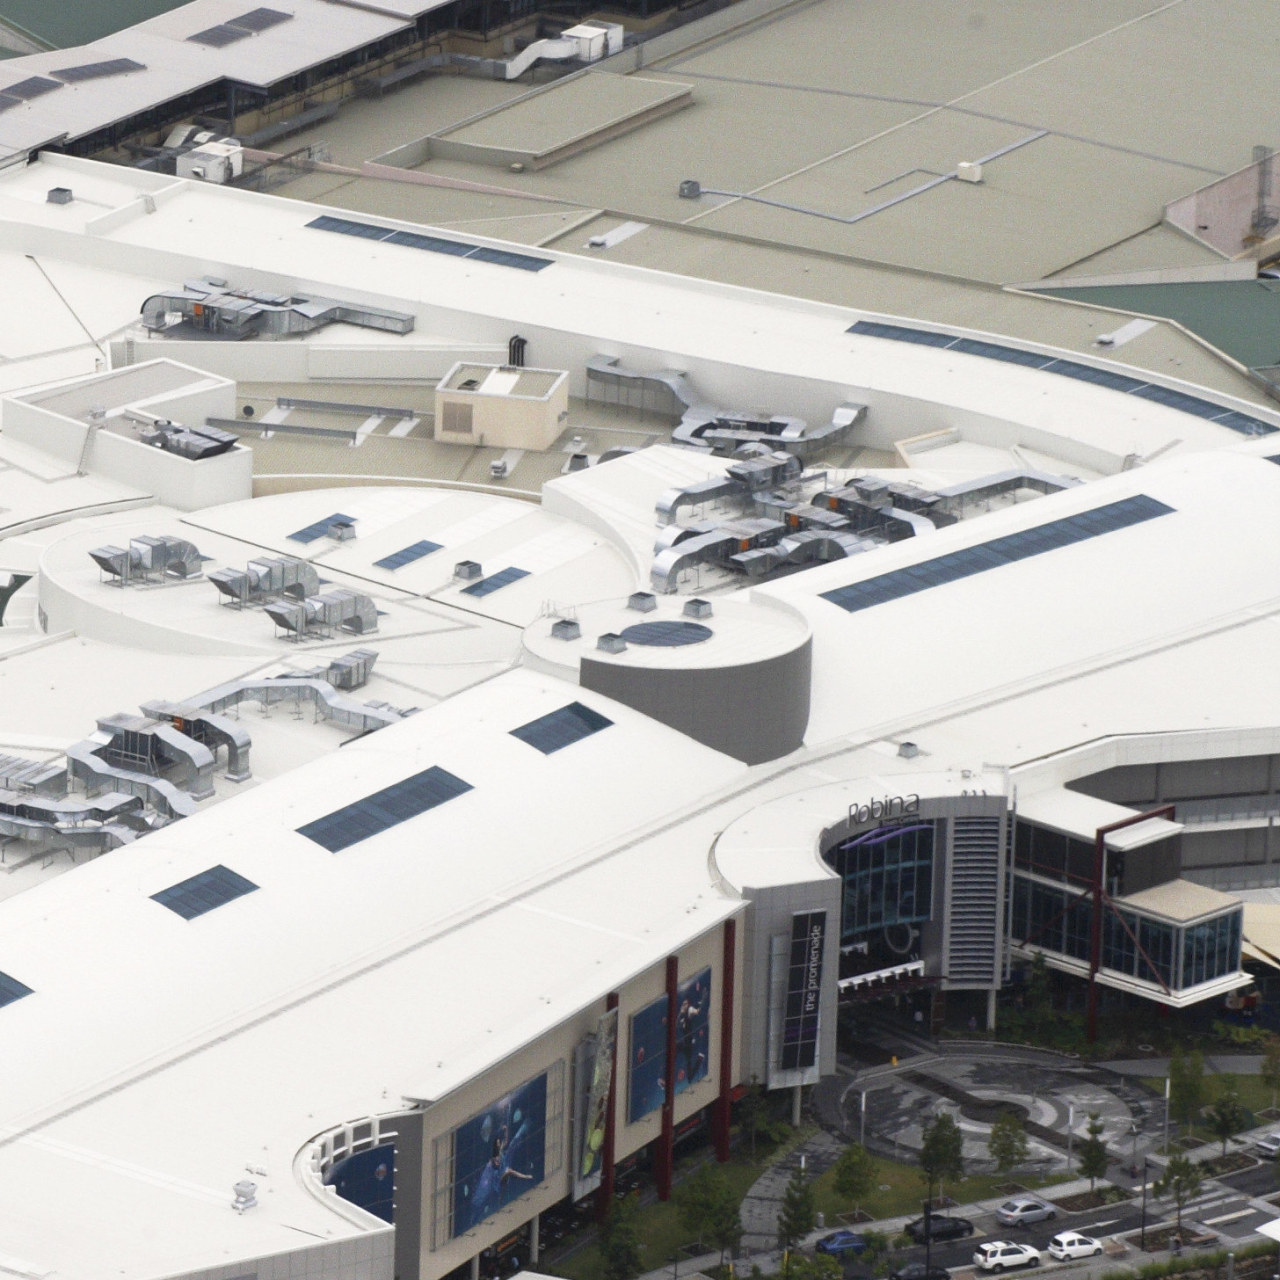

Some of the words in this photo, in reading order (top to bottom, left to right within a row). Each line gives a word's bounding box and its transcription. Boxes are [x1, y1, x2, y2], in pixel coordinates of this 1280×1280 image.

[848, 793, 920, 829] Robina
[808, 925, 821, 989] promenade
[806, 992, 816, 1011] the
